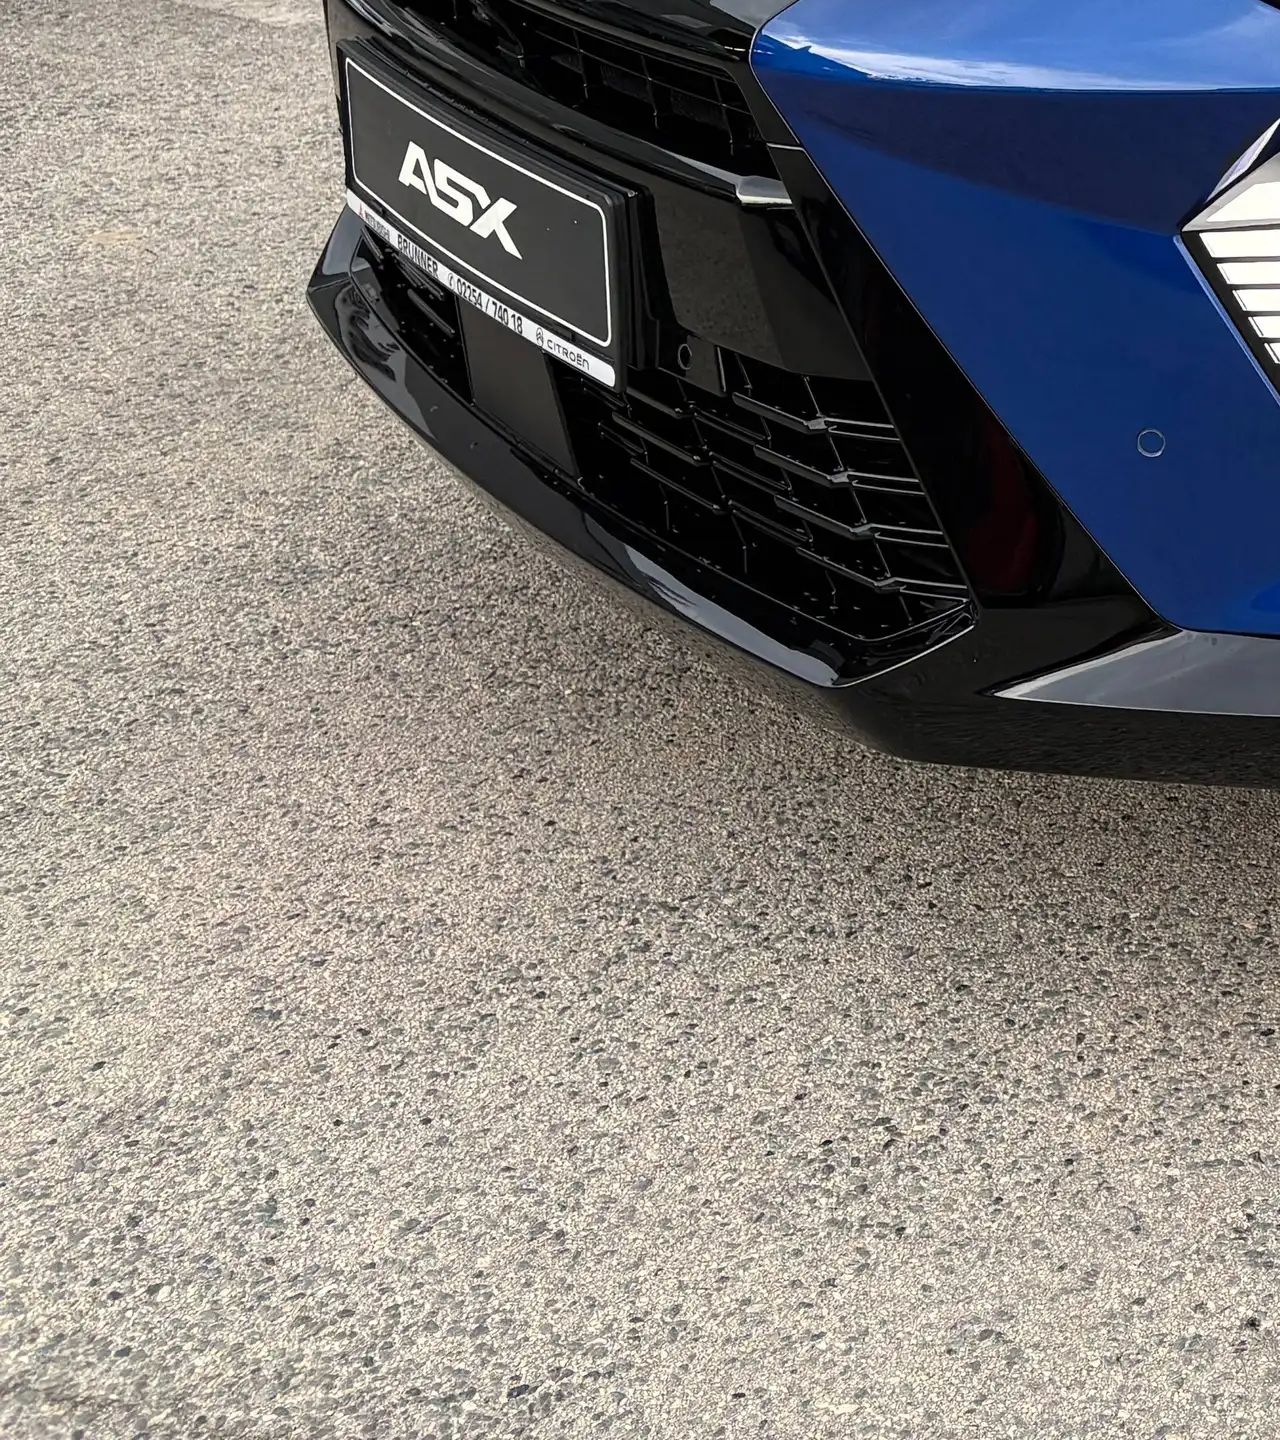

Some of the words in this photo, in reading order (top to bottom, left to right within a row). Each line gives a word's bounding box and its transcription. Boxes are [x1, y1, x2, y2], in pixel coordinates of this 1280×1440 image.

[398, 140, 523, 260] ASX
[396, 233, 440, 279] BRUNNER
[456, 278, 483, 309] 02254
[491, 301, 509, 327] 740
[511, 313, 523, 335] 18
